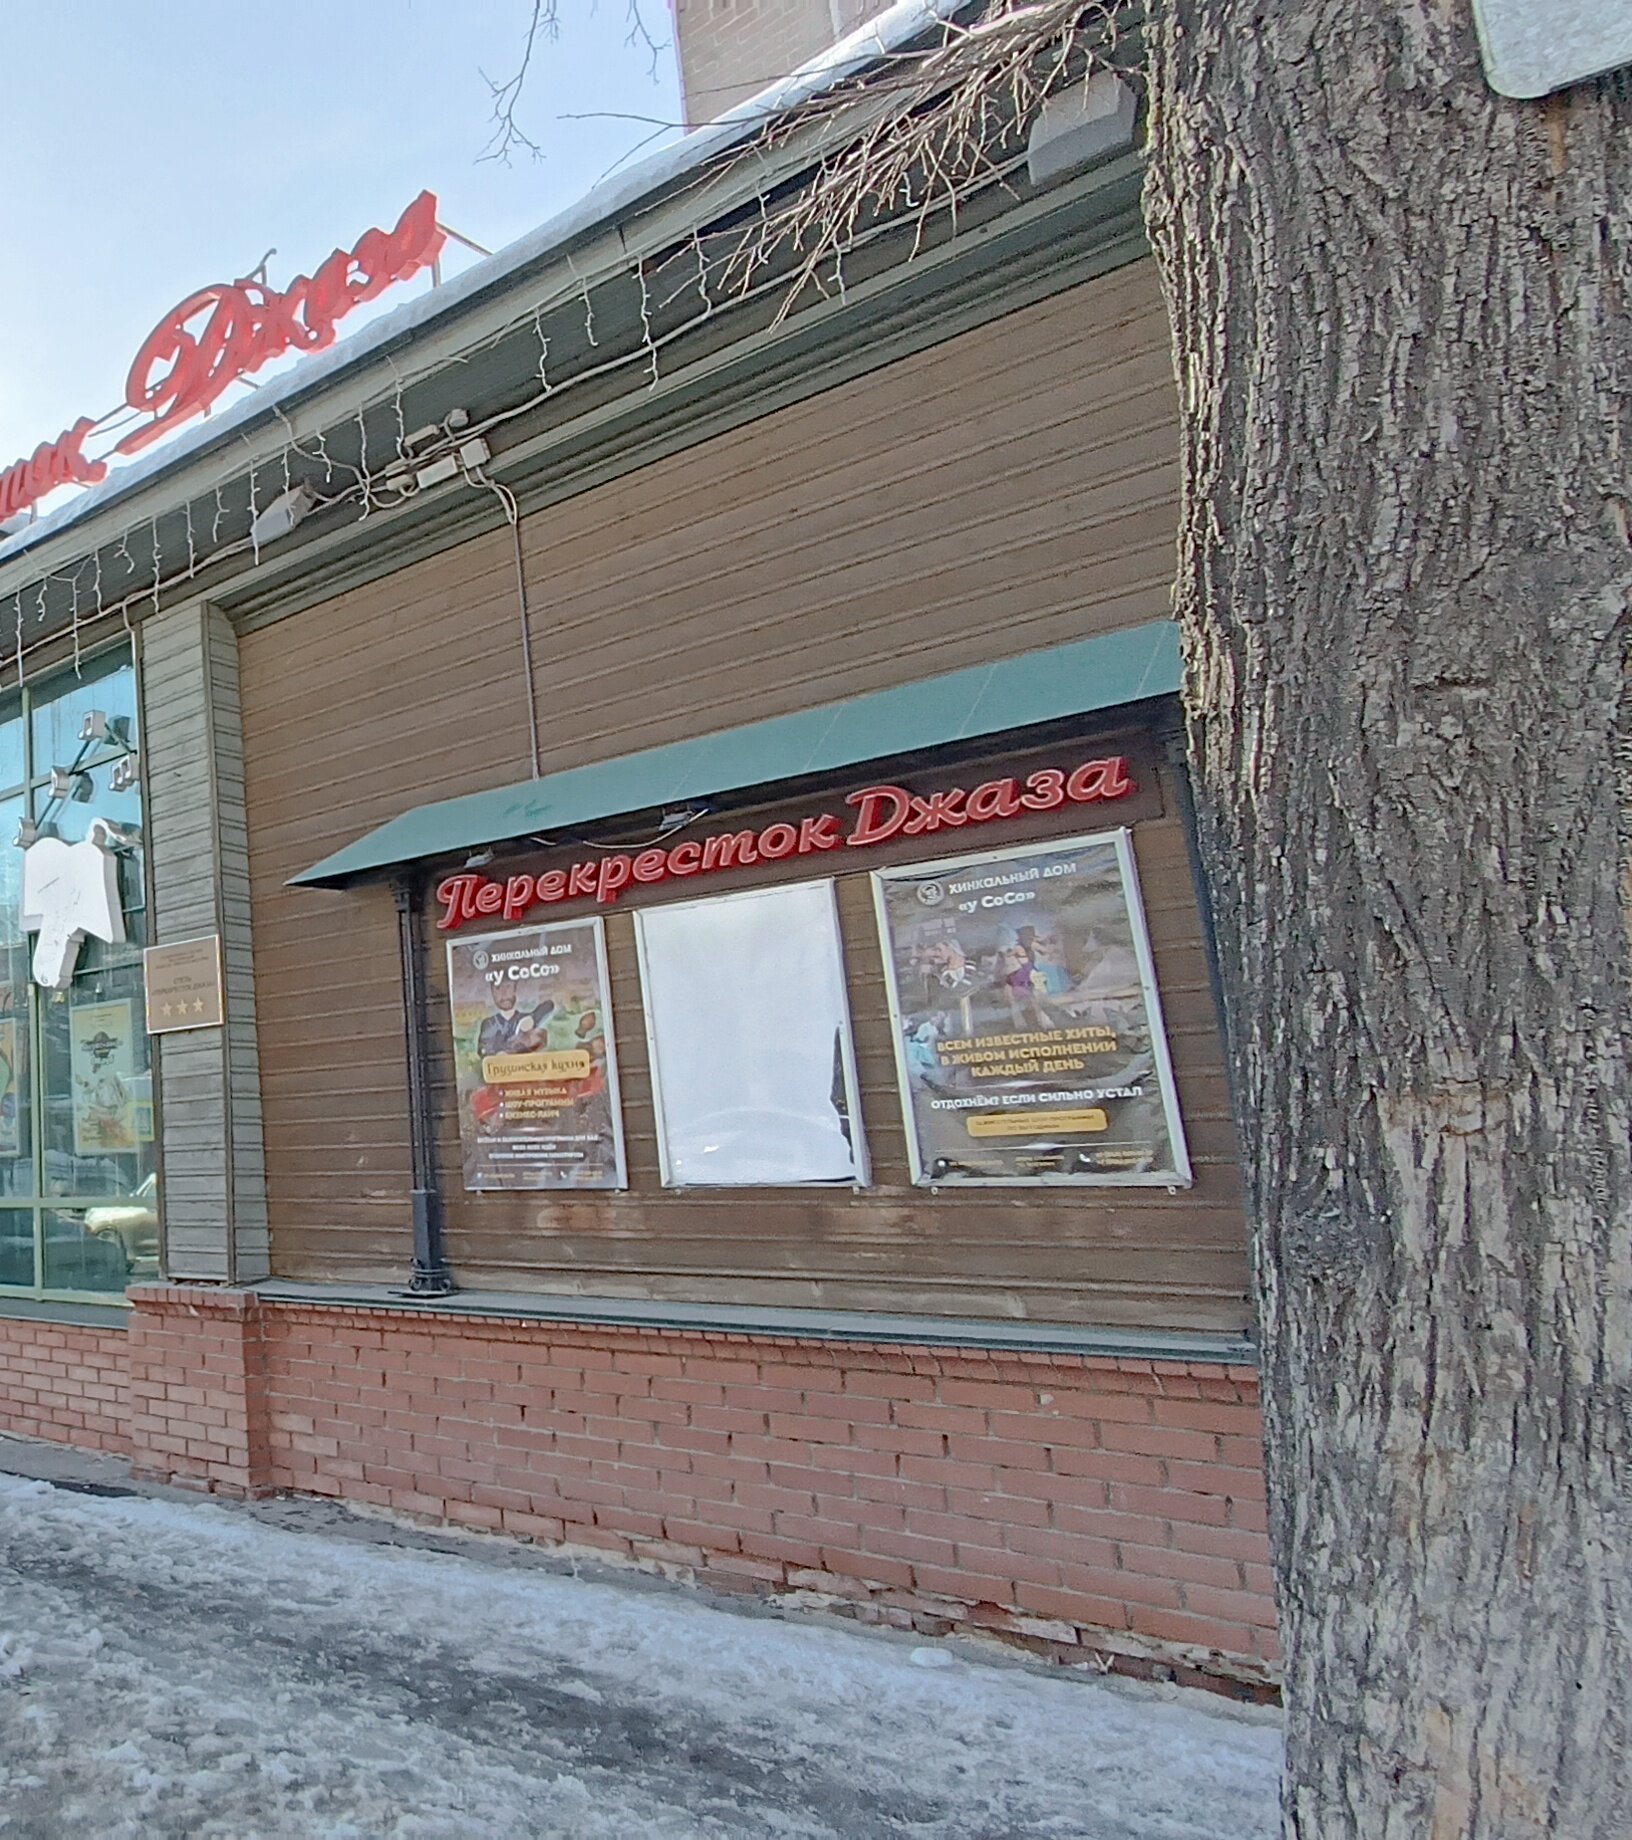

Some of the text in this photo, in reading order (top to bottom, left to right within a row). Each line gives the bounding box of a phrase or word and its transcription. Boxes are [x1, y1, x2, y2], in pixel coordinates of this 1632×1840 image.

[114, 189, 447, 455] Джаза
[435, 757, 1135, 929] Перекресток Джаза
[1043, 862, 1077, 878] ДОМ
[550, 944, 572, 955] ДОМ
[937, 1039, 972, 1053] ВСЕМ
[975, 1031, 1062, 1049] ИЗВЕСТНЫЕ
[940, 1041, 1117, 1066] В ЖИВОМ ИСПОЛНЕНИИ
[971, 1058, 1085, 1078] КАЖДЫЙ ДЕНЬ
[1002, 1094, 1036, 1105] ЕСЛИ
[1038, 1089, 1093, 1103] СИЛЬНО
[1096, 1086, 1143, 1099] УСТАЛ
